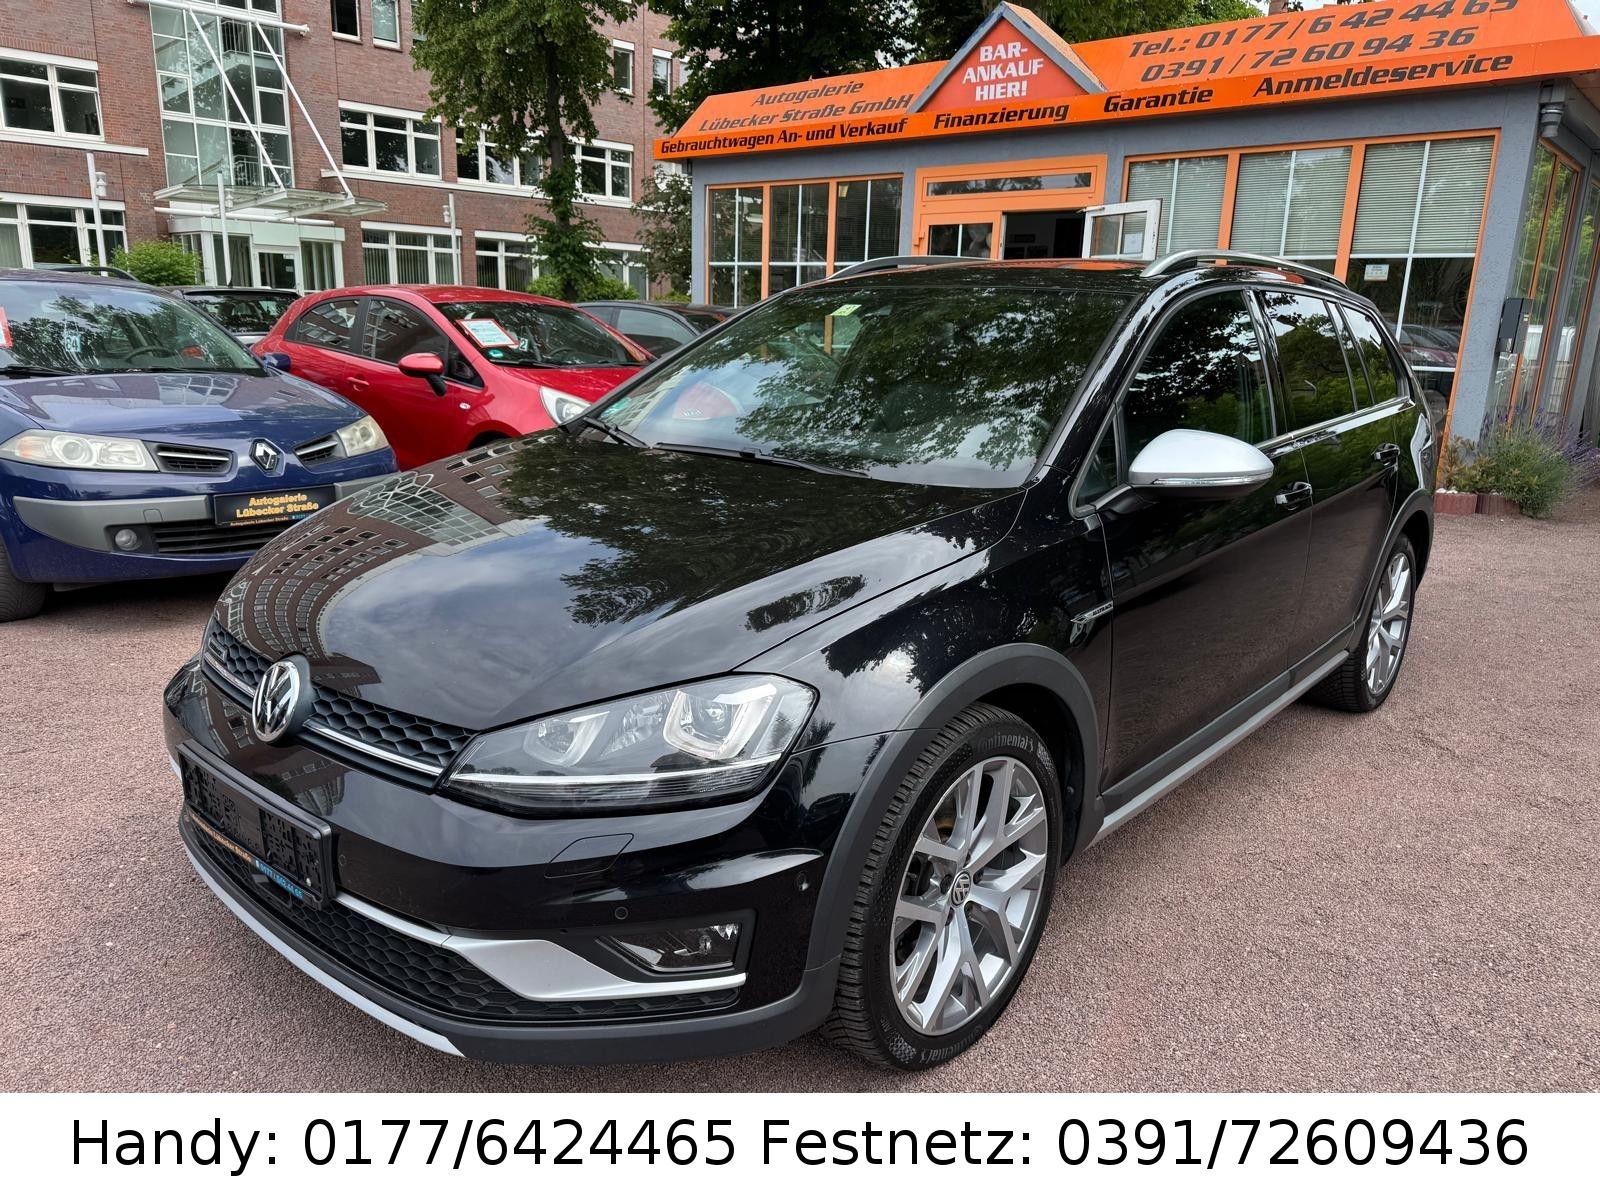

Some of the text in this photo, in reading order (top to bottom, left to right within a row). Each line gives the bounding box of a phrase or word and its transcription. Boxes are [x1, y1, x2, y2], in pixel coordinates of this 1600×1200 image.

[1129, 37, 1191, 58] Tel.:
[1195, 22, 1288, 48] 0177
[1308, 15, 1336, 34] 6
[1339, 8, 1394, 30] 42
[1399, 0, 1456, 22] 44
[980, 41, 1028, 62] BAR-
[1141, 56, 1225, 82] 0391
[1250, 48, 1297, 69] 72
[1301, 41, 1355, 63] 60
[1358, 33, 1415, 56] 94
[1419, 26, 1479, 50] 36
[962, 58, 1044, 84] ANKAUF
[1253, 54, 1514, 97] Anmeldeservice
[752, 81, 864, 106] Autogalerie
[975, 80, 1028, 101] HIER!
[1104, 86, 1213, 113] Garantie
[699, 94, 914, 132] Lübecker Straße GmbH
[933, 104, 1070, 129] Finanzierung
[661, 118, 908, 153] Gebrauchtwagen An- und Verkauf
[236, 506, 284, 518] Lübecker
[286, 502, 319, 513] Straße
[249, 492, 307, 506] Autogalerie
